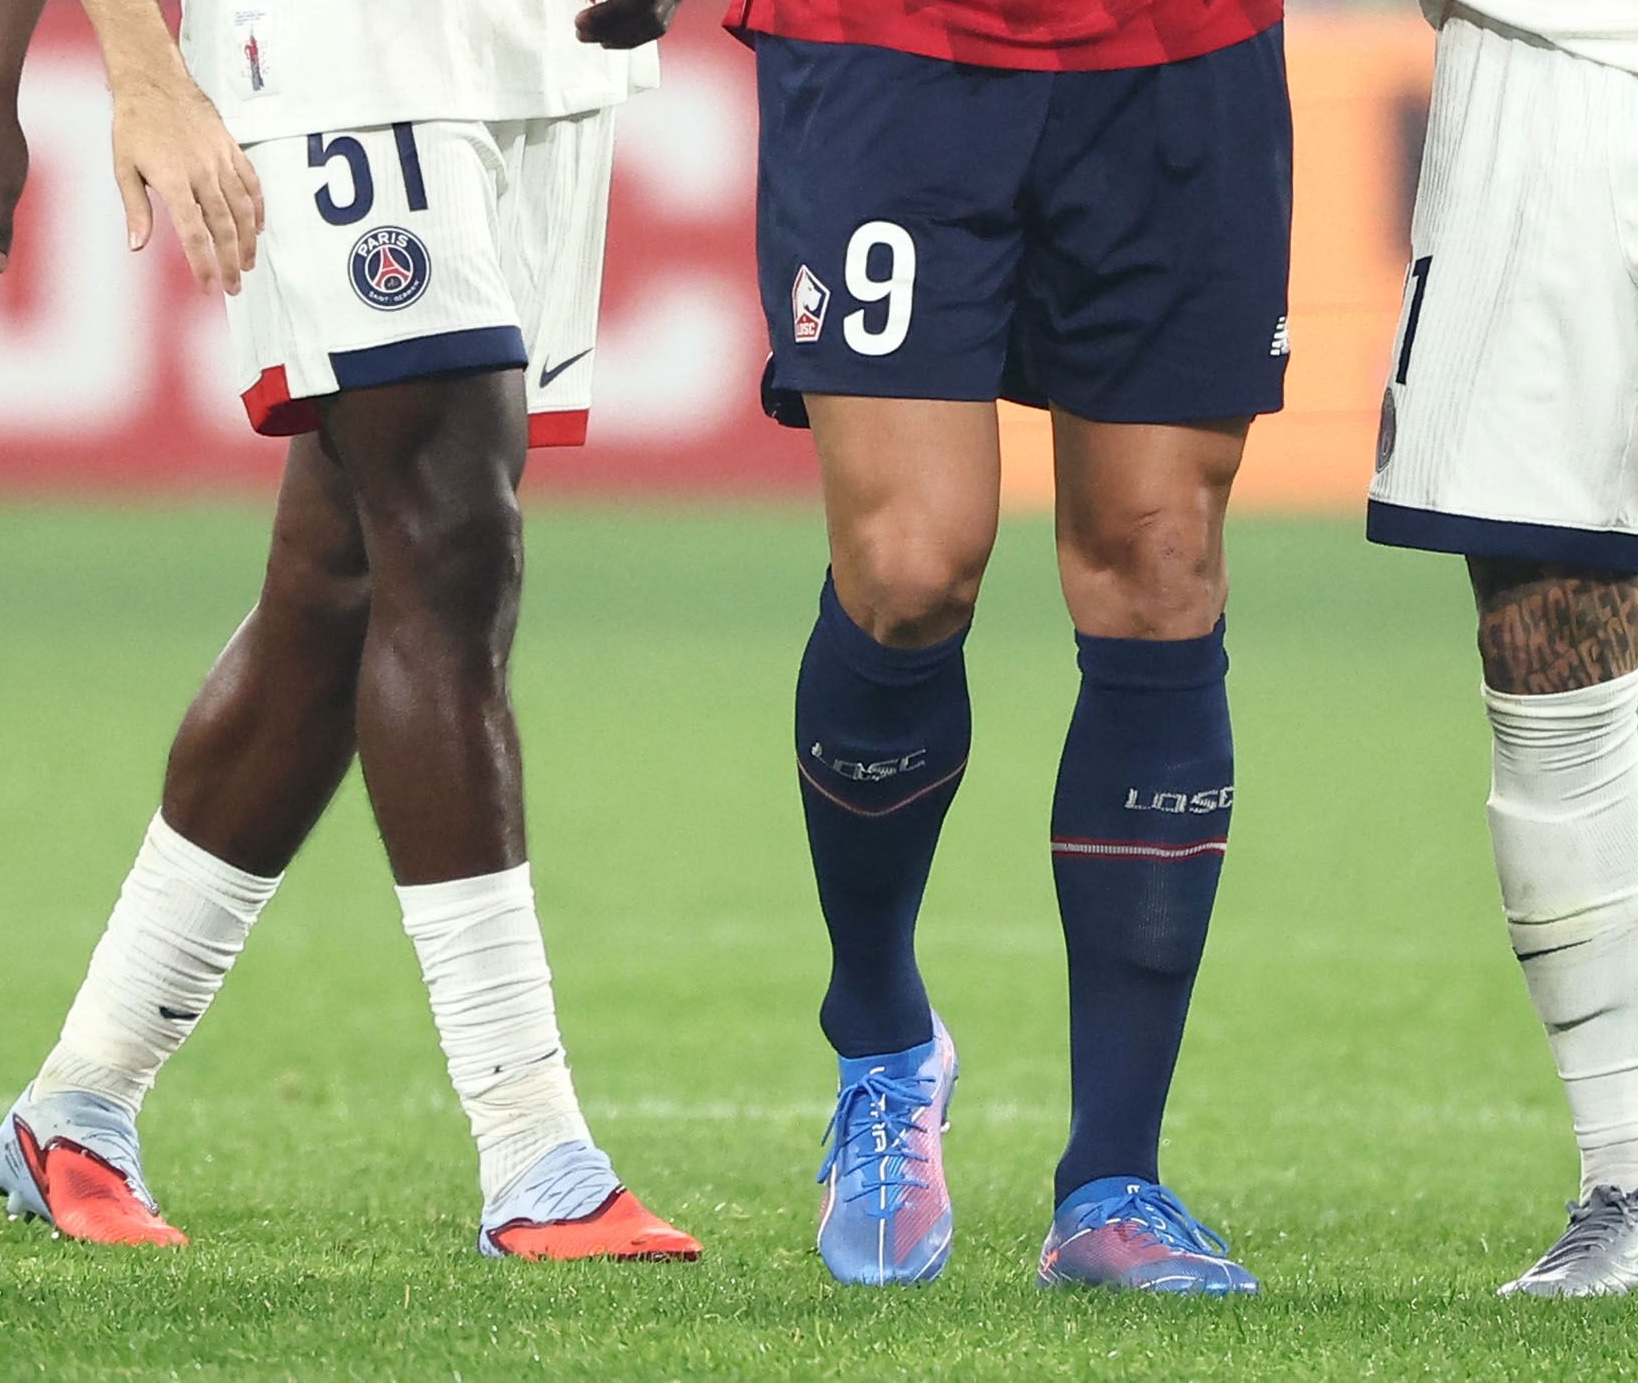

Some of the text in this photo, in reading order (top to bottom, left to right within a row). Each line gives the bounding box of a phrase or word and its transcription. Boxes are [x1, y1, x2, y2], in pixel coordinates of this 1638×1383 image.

[307, 122, 429, 226] 51
[358, 232, 409, 257] PARIS
[843, 220, 916, 356] 9
[1394, 256, 1433, 385] 1
